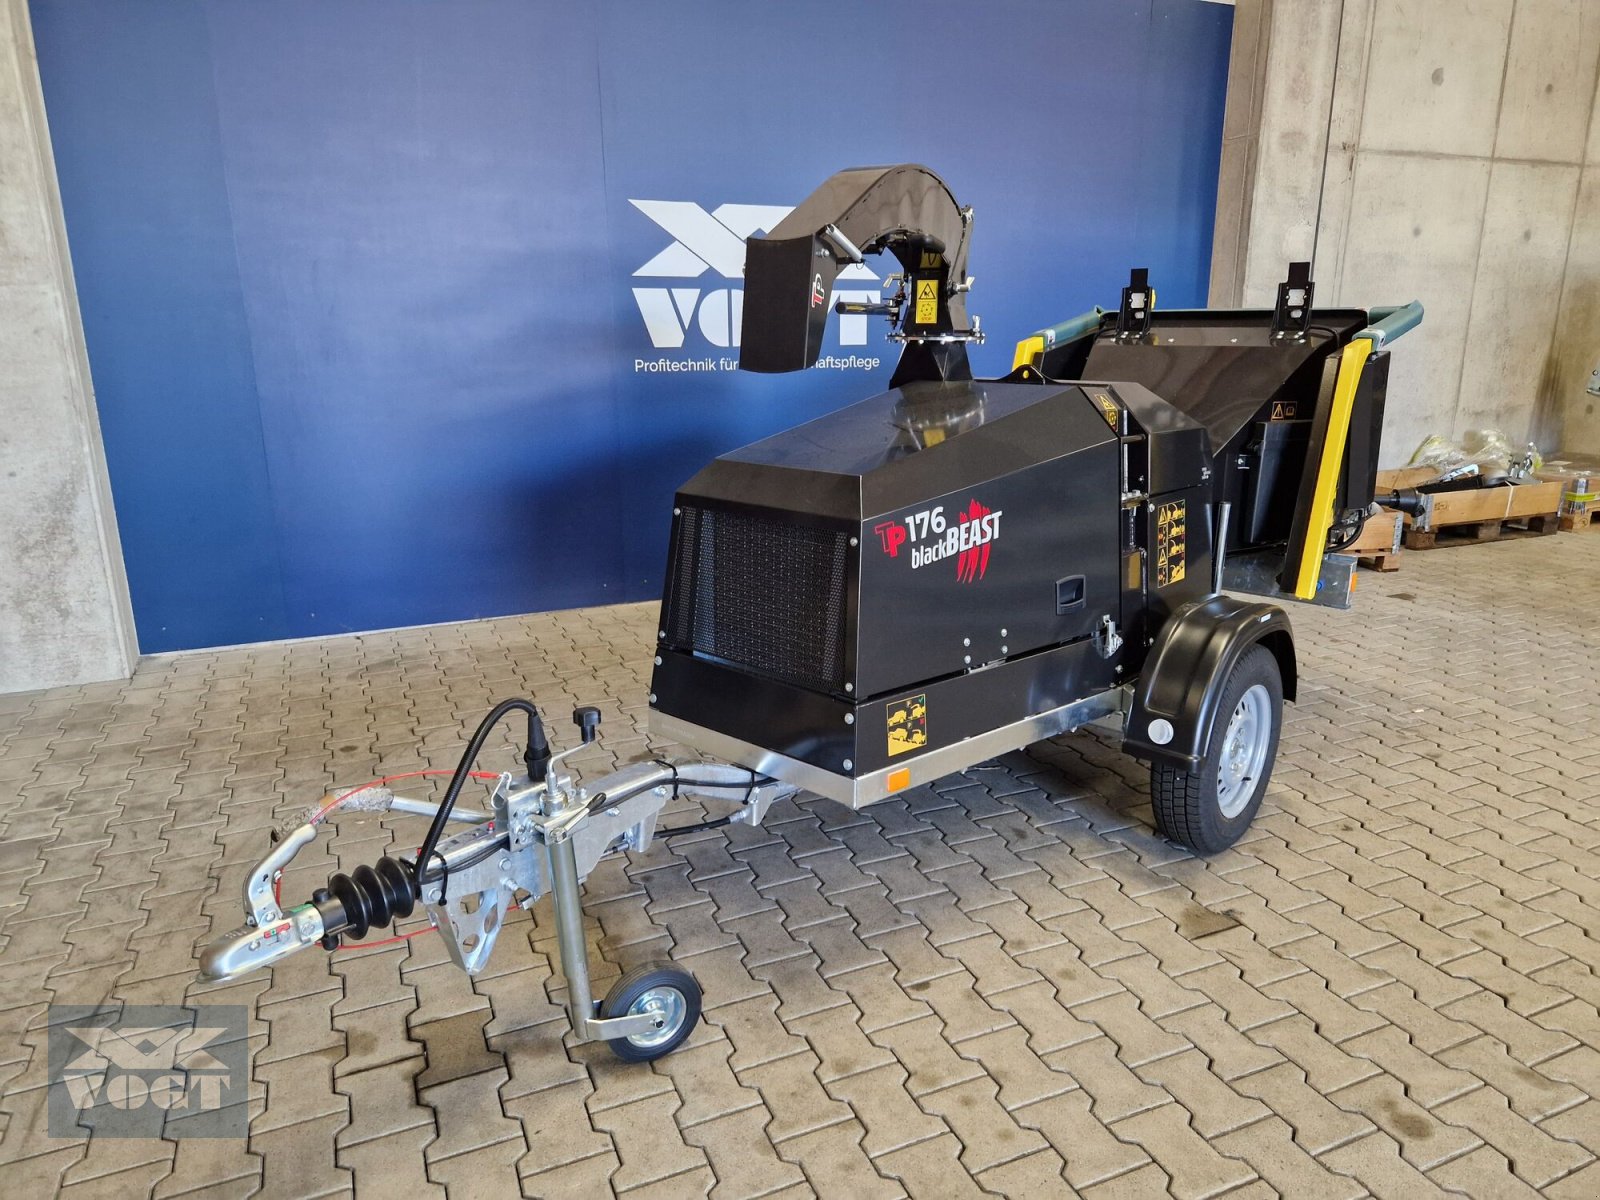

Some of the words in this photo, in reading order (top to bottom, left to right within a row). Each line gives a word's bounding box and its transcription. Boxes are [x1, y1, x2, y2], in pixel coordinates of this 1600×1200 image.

[812, 273, 825, 308] TP
[632, 287, 881, 349] VOT
[634, 358, 717, 372] Profitechnik
[720, 357, 739, 371] für
[813, 355, 881, 371] aftspflege
[874, 520, 907, 558] TP
[905, 506, 947, 542] 176
